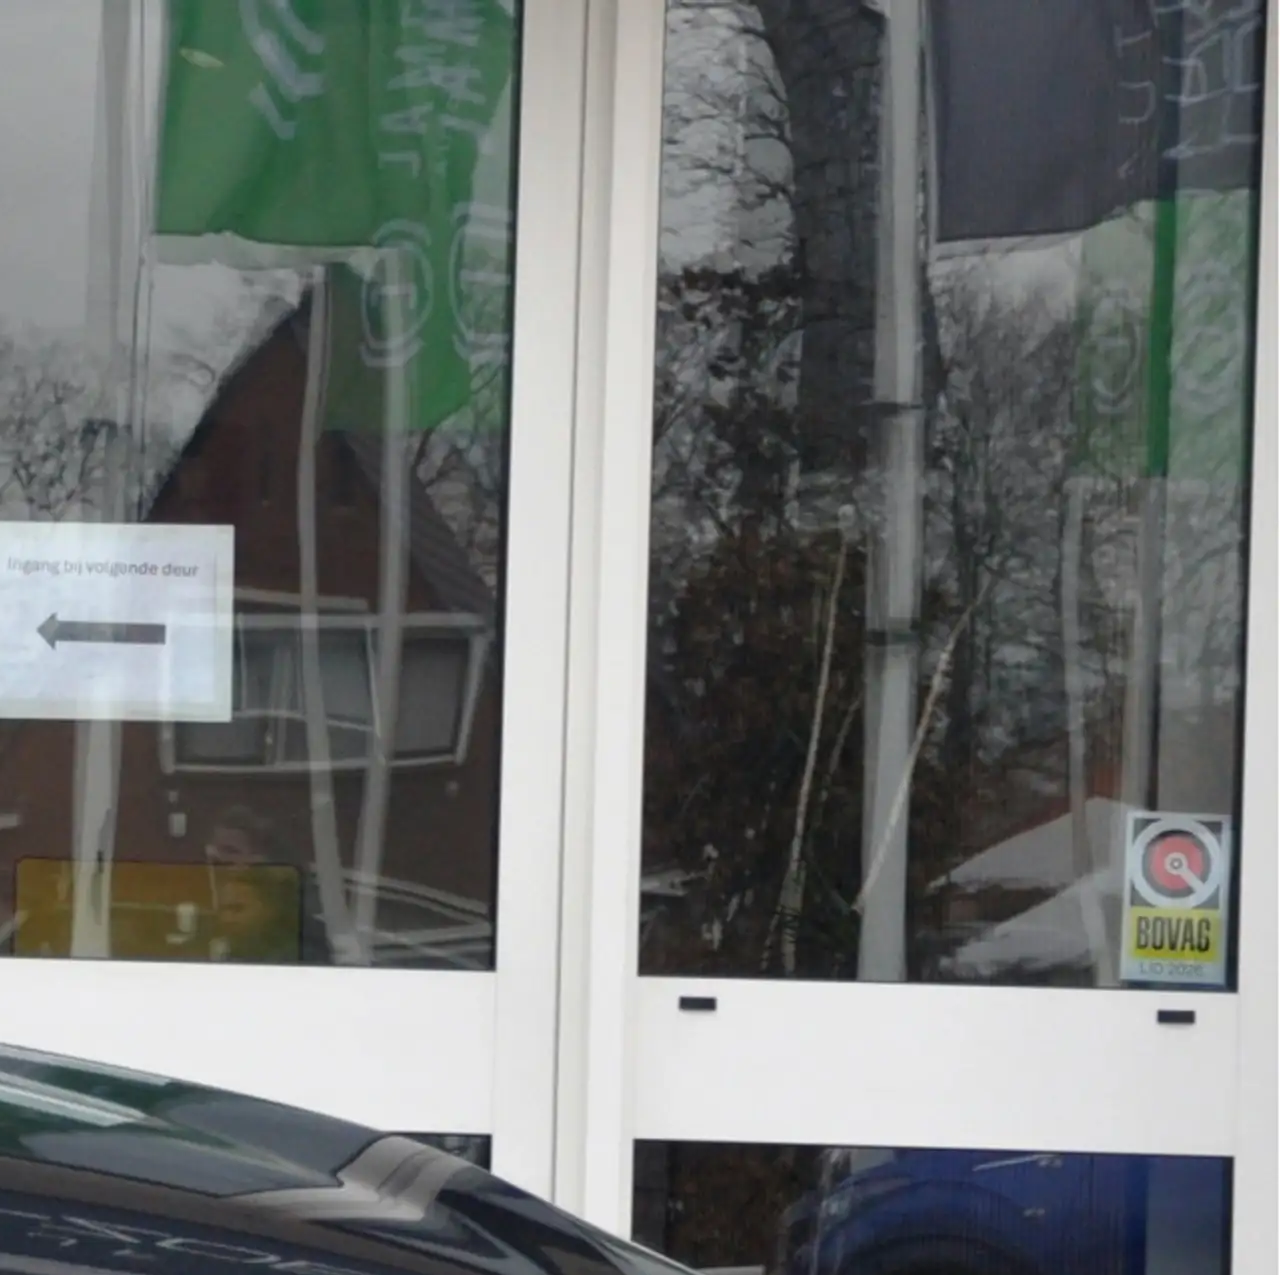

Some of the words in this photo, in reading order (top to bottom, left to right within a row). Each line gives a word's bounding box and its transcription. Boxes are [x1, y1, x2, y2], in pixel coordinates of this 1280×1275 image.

[7, 556, 60, 576] Ingang
[64, 559, 83, 577] bij
[85, 560, 159, 578] volgende
[162, 562, 200, 577] deur
[1136, 916, 1211, 952] BOVAG
